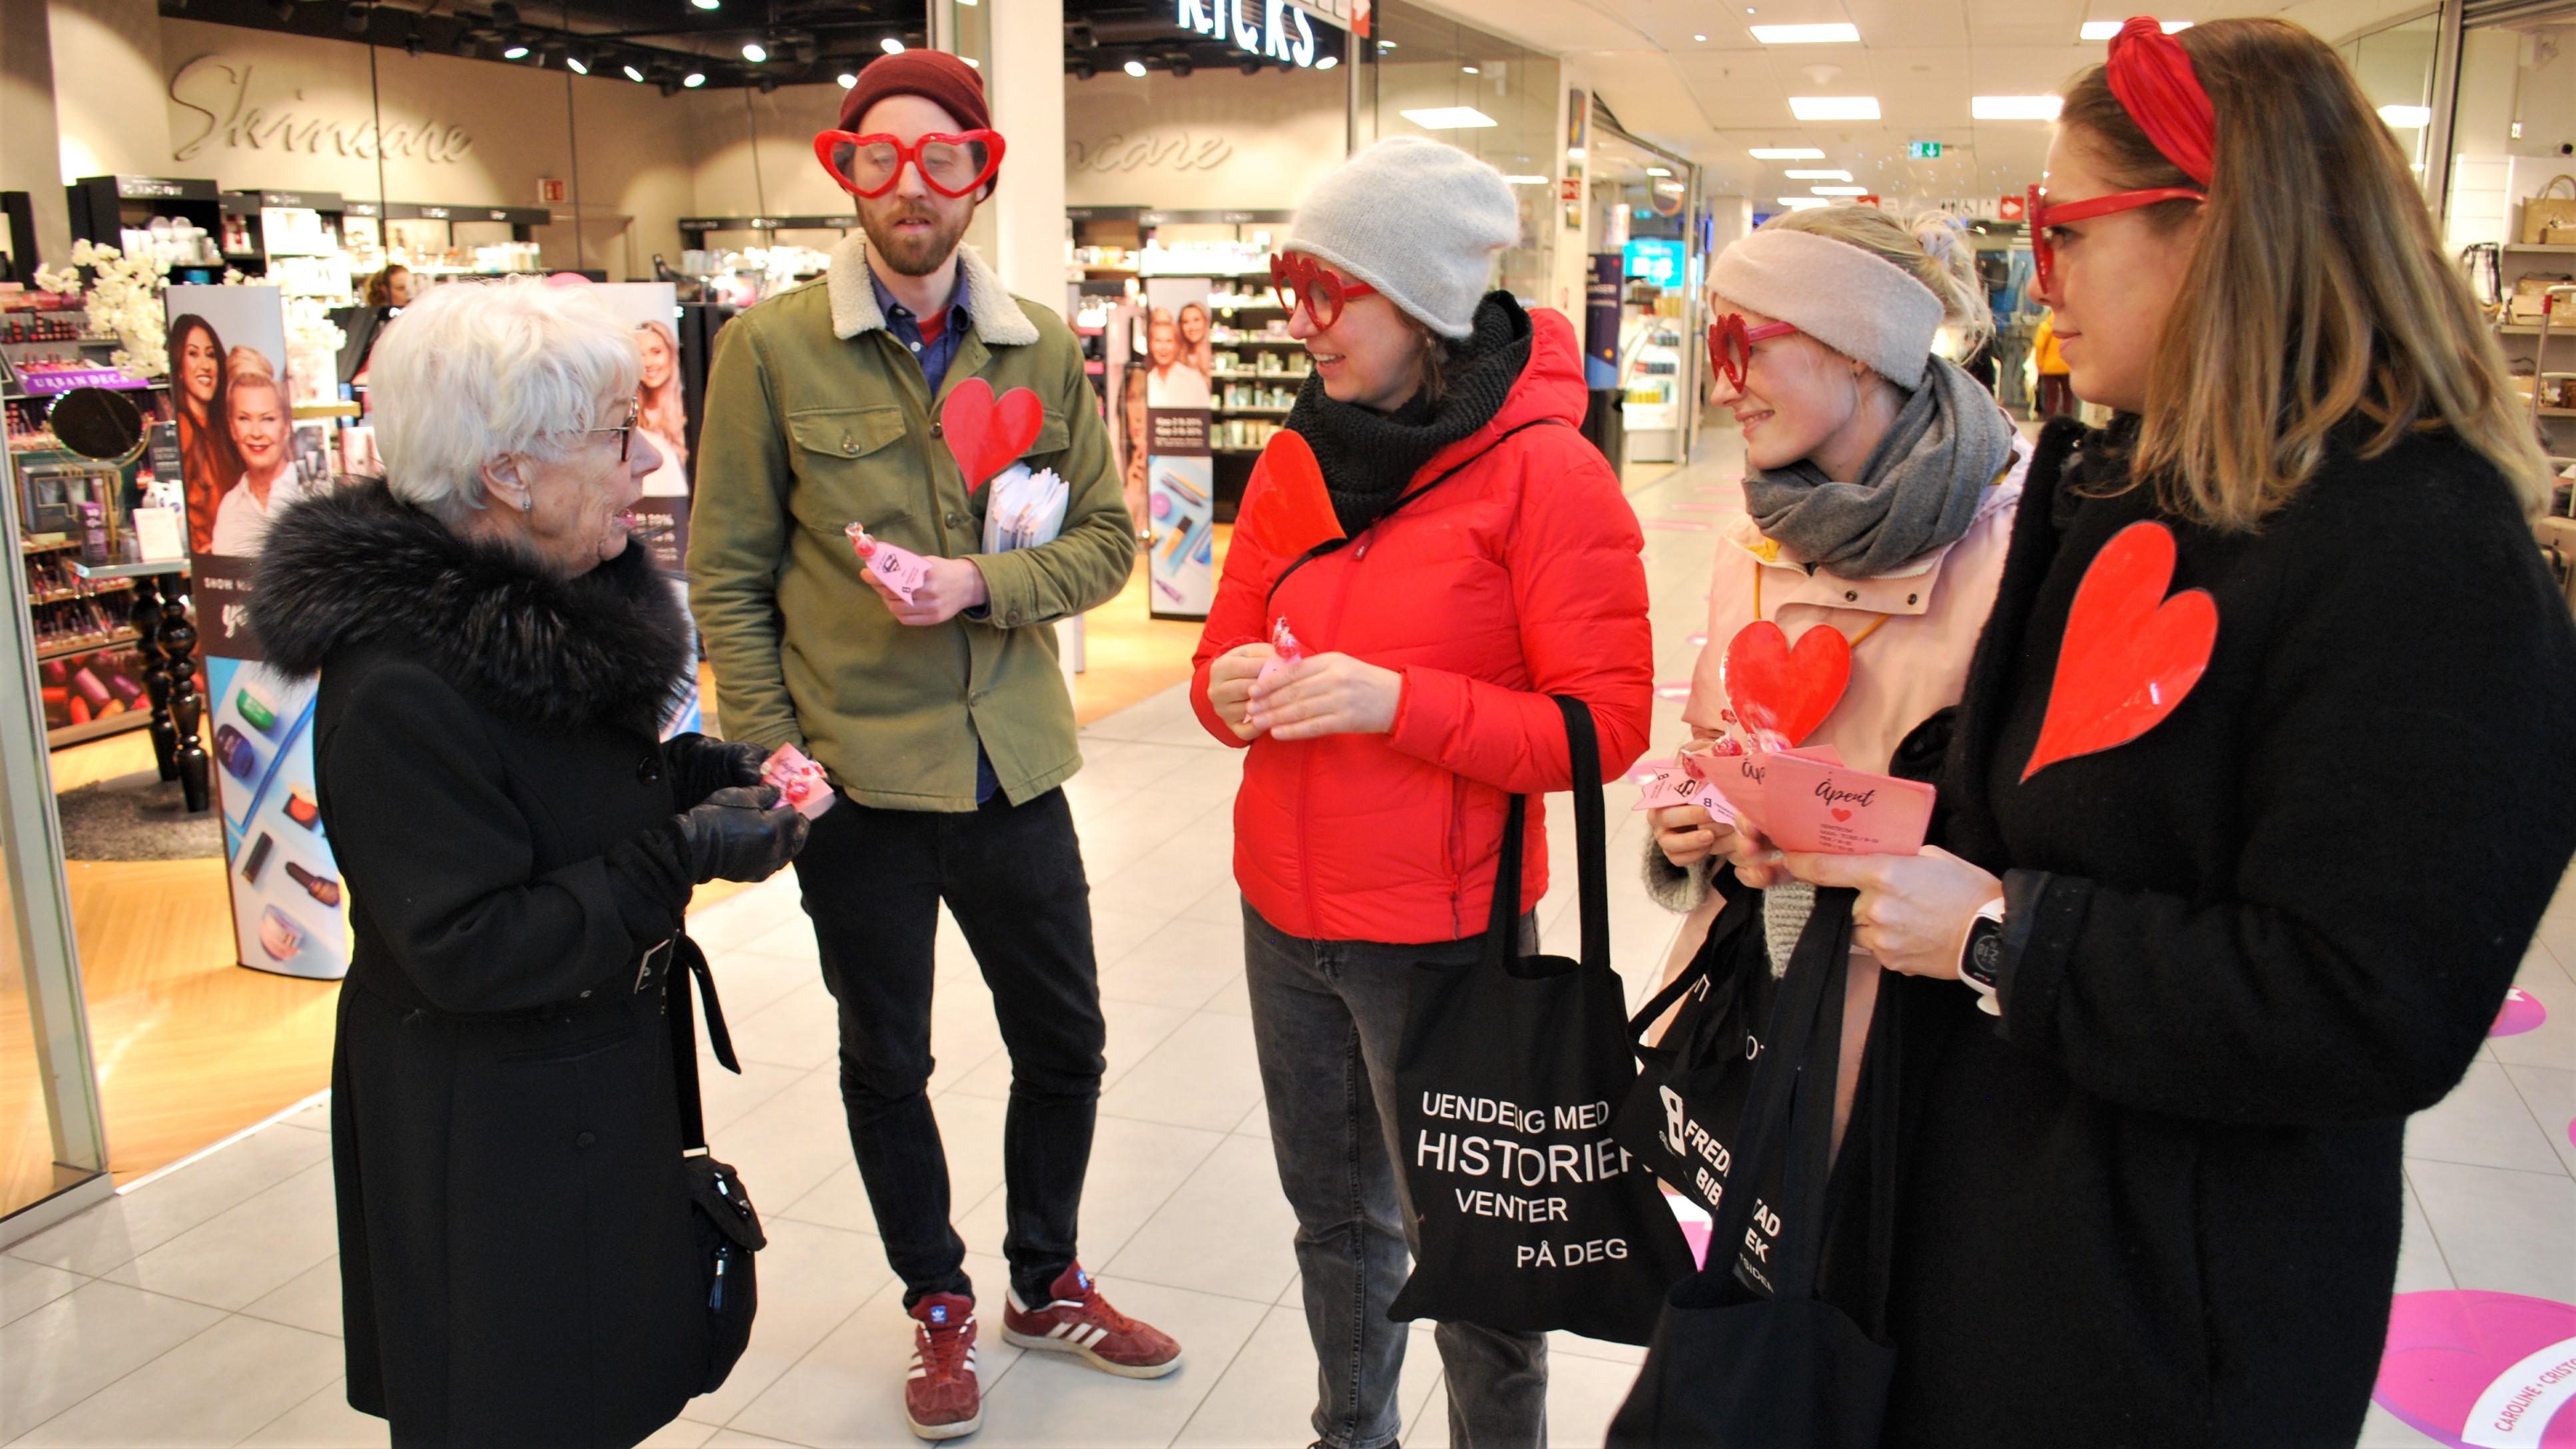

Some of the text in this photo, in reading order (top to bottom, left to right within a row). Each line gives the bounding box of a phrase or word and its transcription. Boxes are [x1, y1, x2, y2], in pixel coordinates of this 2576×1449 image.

[169, 53, 471, 162] Skincare
[33, 373, 130, 390] URBAN DECA
[1815, 771, 1876, 807] Åpent
[1422, 1091, 1609, 1133] UENDELIG MED
[1455, 1188, 1569, 1223] VENTER
[1517, 1239, 1628, 1268] PÅ DEG
[2494, 1385, 2543, 1432] CAROLINE
